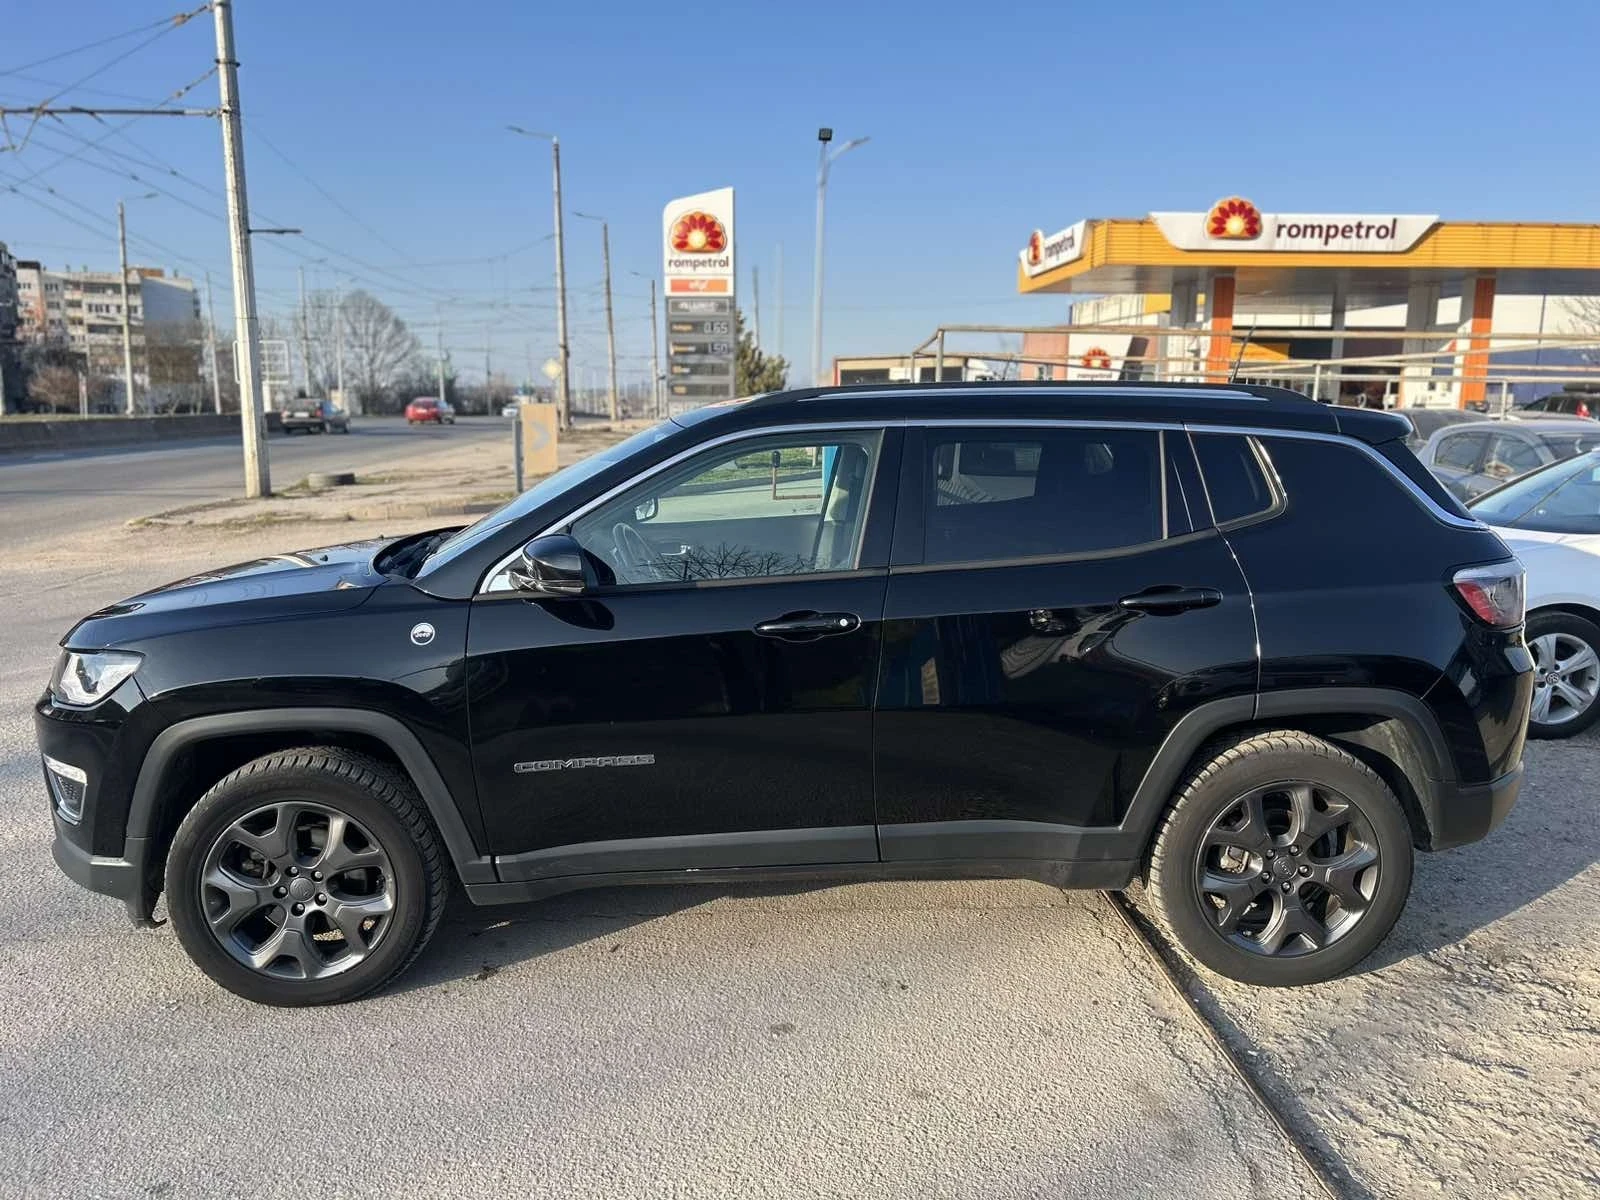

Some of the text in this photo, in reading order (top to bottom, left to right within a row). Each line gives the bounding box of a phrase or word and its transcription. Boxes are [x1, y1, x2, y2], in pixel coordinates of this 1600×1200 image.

[1276, 218, 1397, 246] rompetrol
[668, 255, 729, 271] rompetrol
[513, 754, 656, 773] COMPASS
